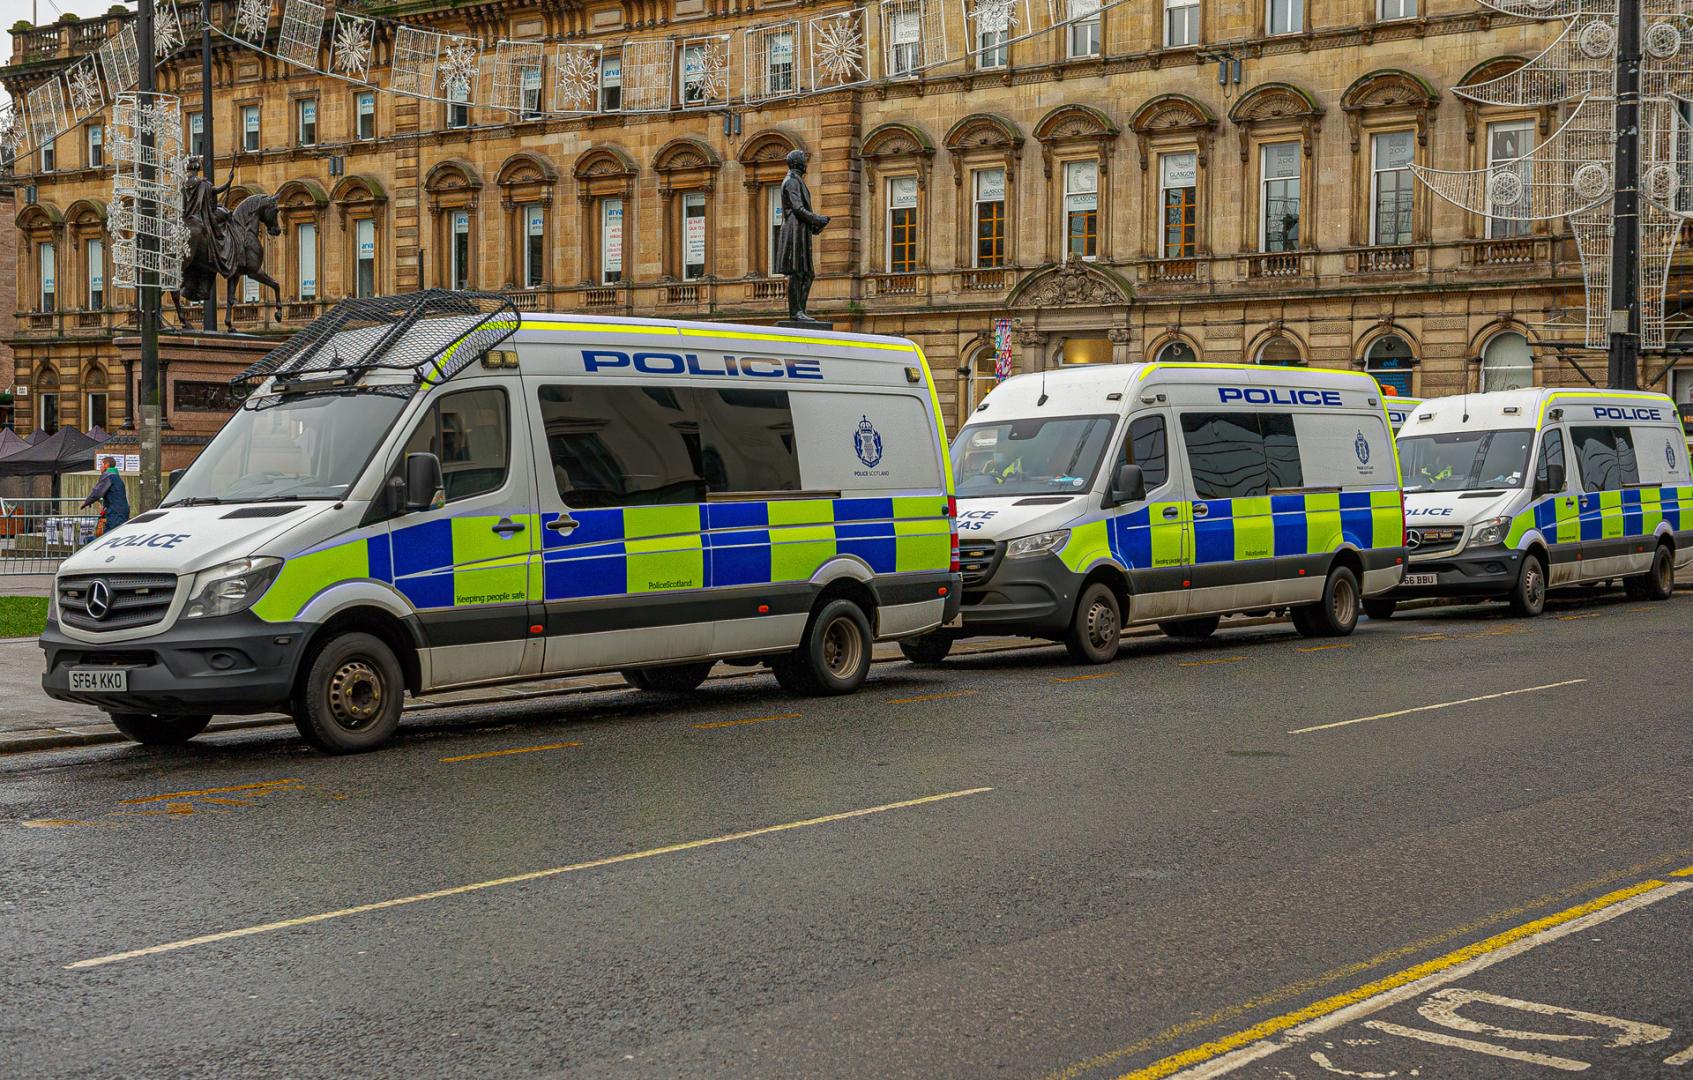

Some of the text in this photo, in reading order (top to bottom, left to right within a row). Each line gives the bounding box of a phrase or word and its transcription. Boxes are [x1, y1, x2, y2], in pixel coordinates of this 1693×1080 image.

[581, 350, 824, 380] POLICE
[1218, 387, 1342, 406] POLICE
[1593, 407, 1662, 420] POLICE
[959, 510, 999, 520] ICE
[93, 533, 192, 552] POLICE
[648, 579, 693, 590] PoliceScotland
[1417, 575, 1434, 584] BBU
[456, 590, 526, 604] Keeping people safe
[72, 673, 98, 689] SF64
